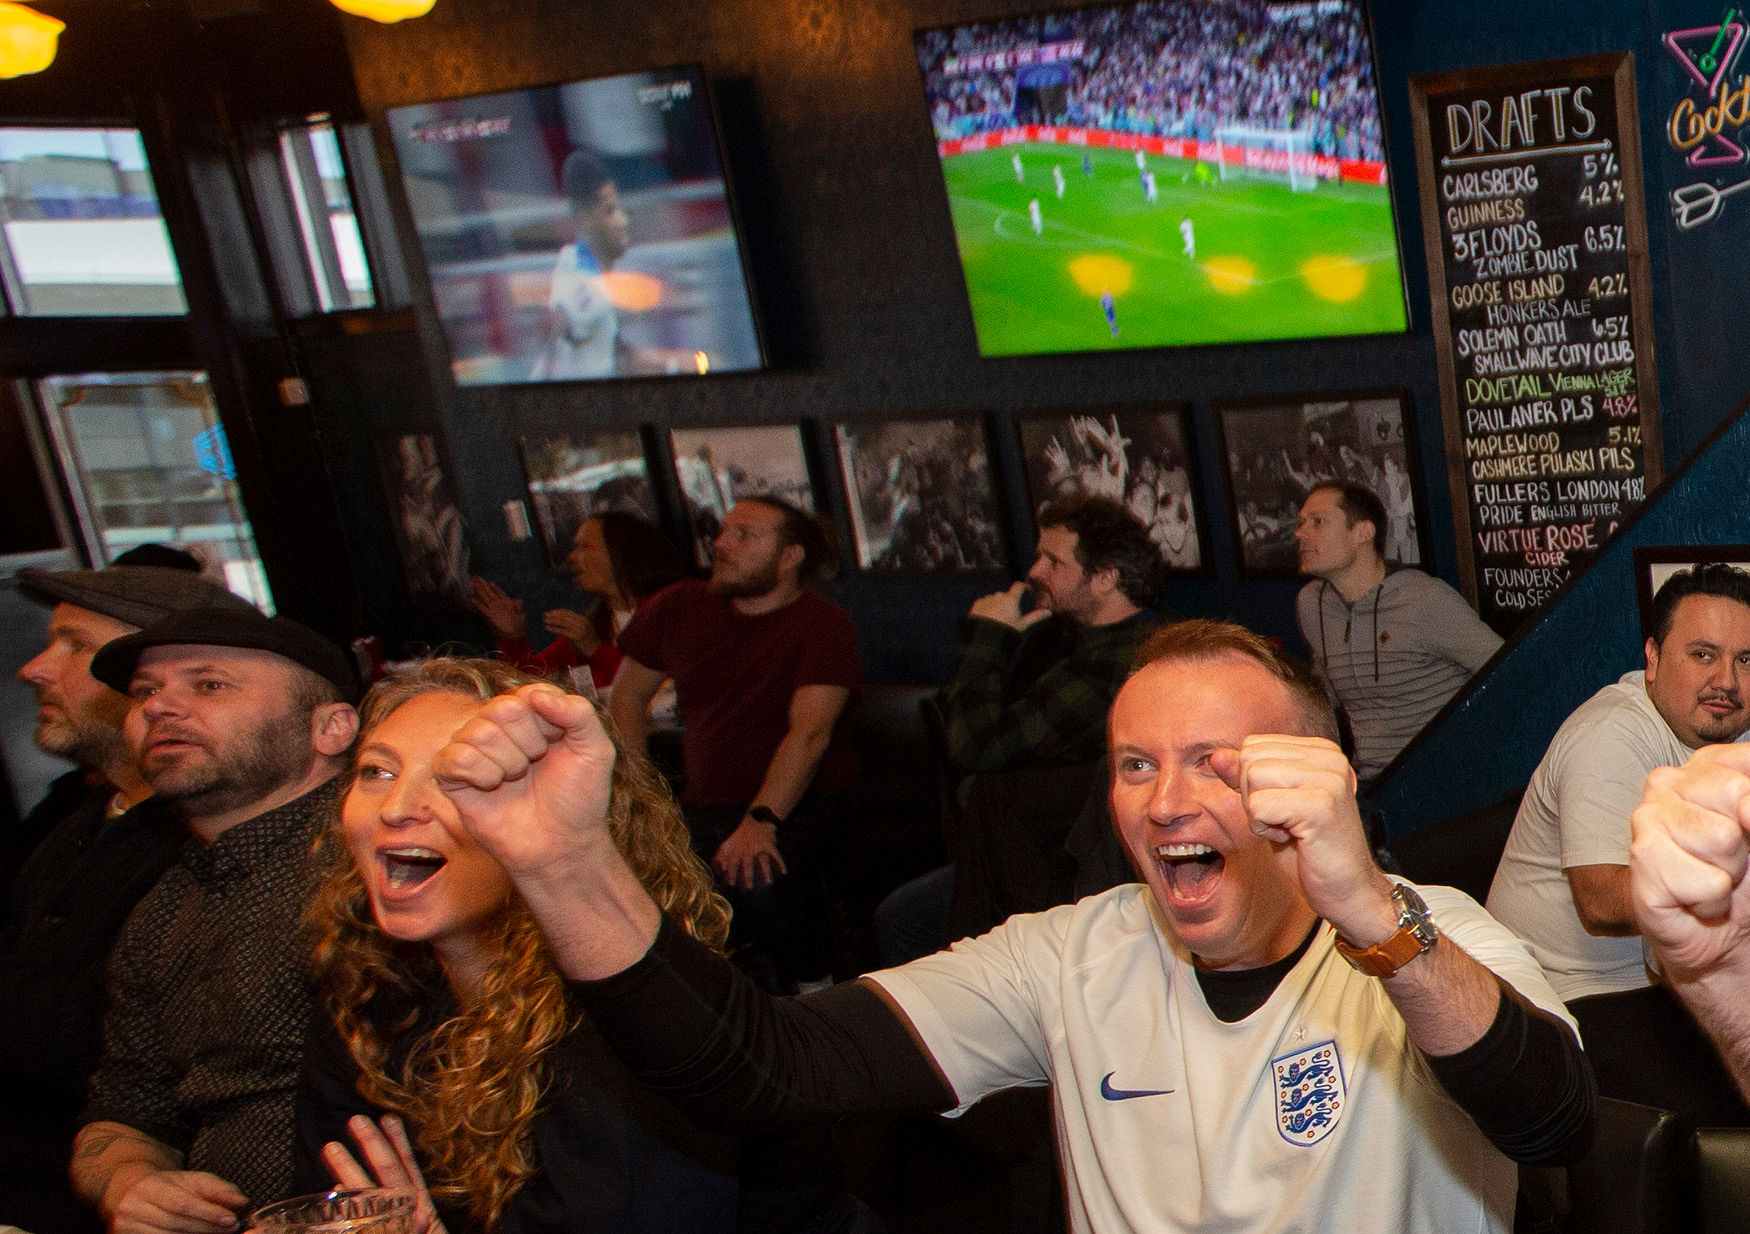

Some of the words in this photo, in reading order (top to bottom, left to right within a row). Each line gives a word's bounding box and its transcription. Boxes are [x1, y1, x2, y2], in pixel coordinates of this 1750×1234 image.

[1447, 86, 1596, 154] DRAFTS
[1443, 164, 1539, 201] CARLSBERG
[1583, 152, 1619, 179] 5%
[1447, 198, 1526, 231] GUINNESS
[1579, 180, 1625, 208] 4.2%
[1584, 224, 1626, 254] 6.5%
[1473, 250, 1536, 280] ZOMBIE
[1535, 244, 1579, 274] DUST
[1452, 281, 1503, 309] GOOSE
[1508, 273, 1565, 301] ISLAND
[1588, 273, 1628, 299] 4.2%
[1486, 299, 1561, 326] HONKERS
[1562, 298, 1592, 318] ALE
[1458, 324, 1520, 357] SOLEMN
[1523, 320, 1567, 346] OATH
[1594, 339, 1636, 365] CLUB
[1465, 374, 1552, 404] DOVETAIL
[1549, 371, 1596, 393] VIENNA
[1594, 367, 1636, 388] LAGER
[1466, 400, 1559, 435] PAULANER
[1466, 432, 1560, 459] MAPLEWOOD
[1471, 455, 1538, 480] CASHMERE
[1540, 448, 1595, 476] PULASKI
[1599, 447, 1635, 472] PILS
[1474, 481, 1550, 505] FULLERS
[1556, 479, 1621, 501] LONDON
[1479, 505, 1524, 527] PRIDE
[1530, 503, 1577, 521] ENGLISH
[1582, 501, 1622, 517] BITTER
[1477, 526, 1543, 554] VIRTUE
[1545, 516, 1599, 551] ROSÉ
[1525, 551, 1570, 567] CIDER
